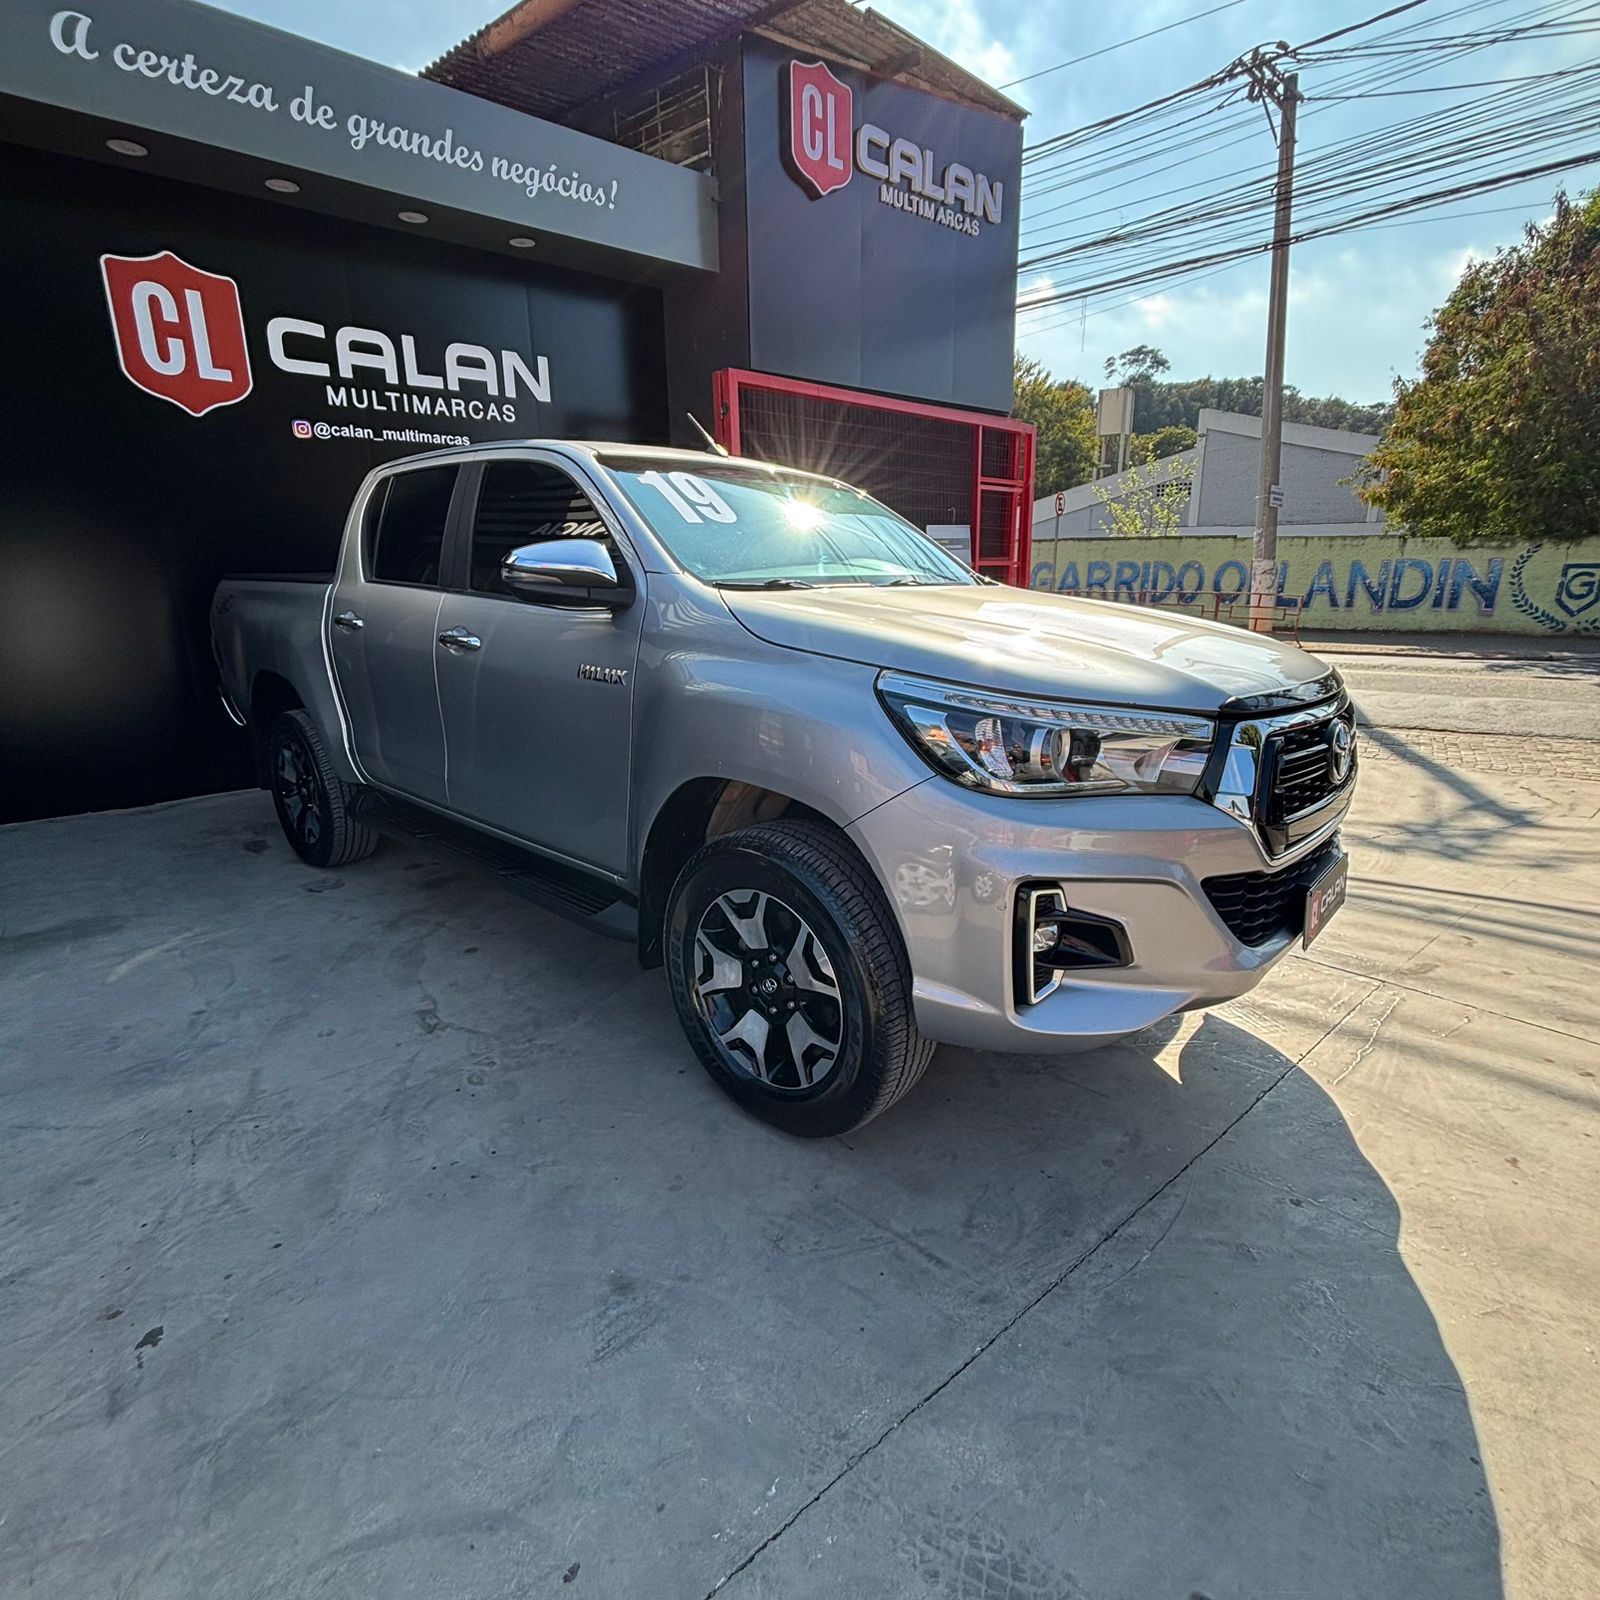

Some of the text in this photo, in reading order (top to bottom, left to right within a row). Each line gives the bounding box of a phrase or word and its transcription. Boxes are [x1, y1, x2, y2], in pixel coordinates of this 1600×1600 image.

[113, 43, 279, 112] certeza
[289, 85, 337, 130] de
[347, 113, 484, 172] grandes
[491, 164, 618, 210] negócios!
[801, 83, 844, 171] CL
[856, 123, 1003, 224] CALAN
[880, 183, 980, 237] MULTIMARCAS
[131, 280, 232, 383] CL
[266, 317, 552, 403] CALAN
[326, 385, 516, 423] MULTIMARCAS
[313, 421, 470, 446] @calan_multimarcas
[636, 470, 737, 523] 19
[1031, 558, 1504, 612] GARRIDO OLANDIN
[577, 663, 628, 686] HILUX
